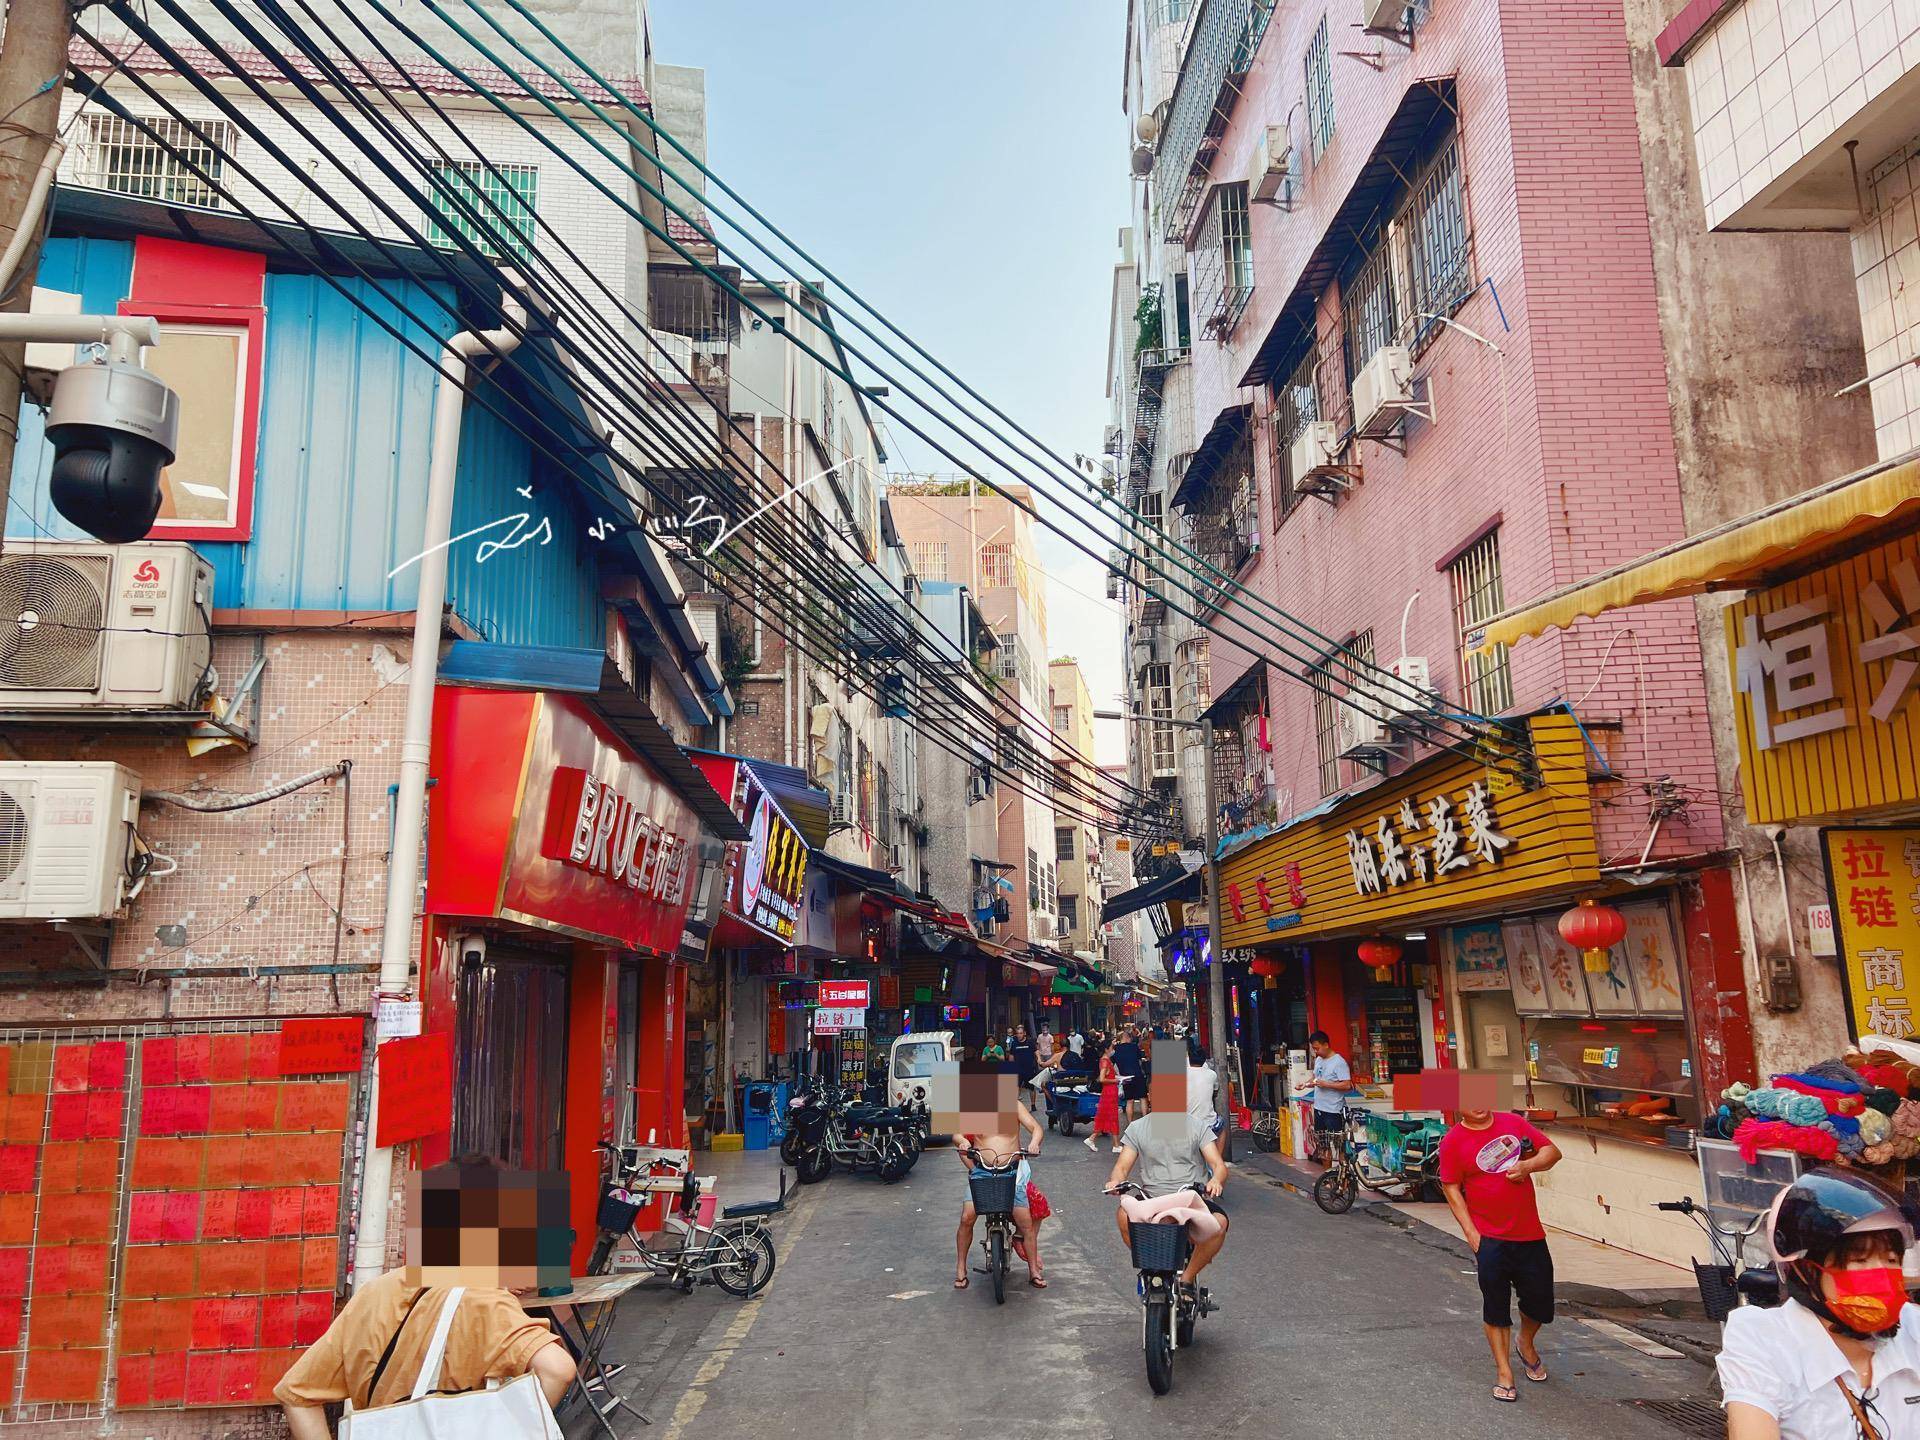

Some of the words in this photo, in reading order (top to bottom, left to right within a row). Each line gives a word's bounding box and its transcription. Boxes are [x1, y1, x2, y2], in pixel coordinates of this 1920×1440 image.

[1841, 838, 1898, 928] 拉链
[1858, 946, 1915, 1039] 商标
[817, 1012, 861, 1025] 拉链厂
[842, 1040, 865, 1049] 拉链
